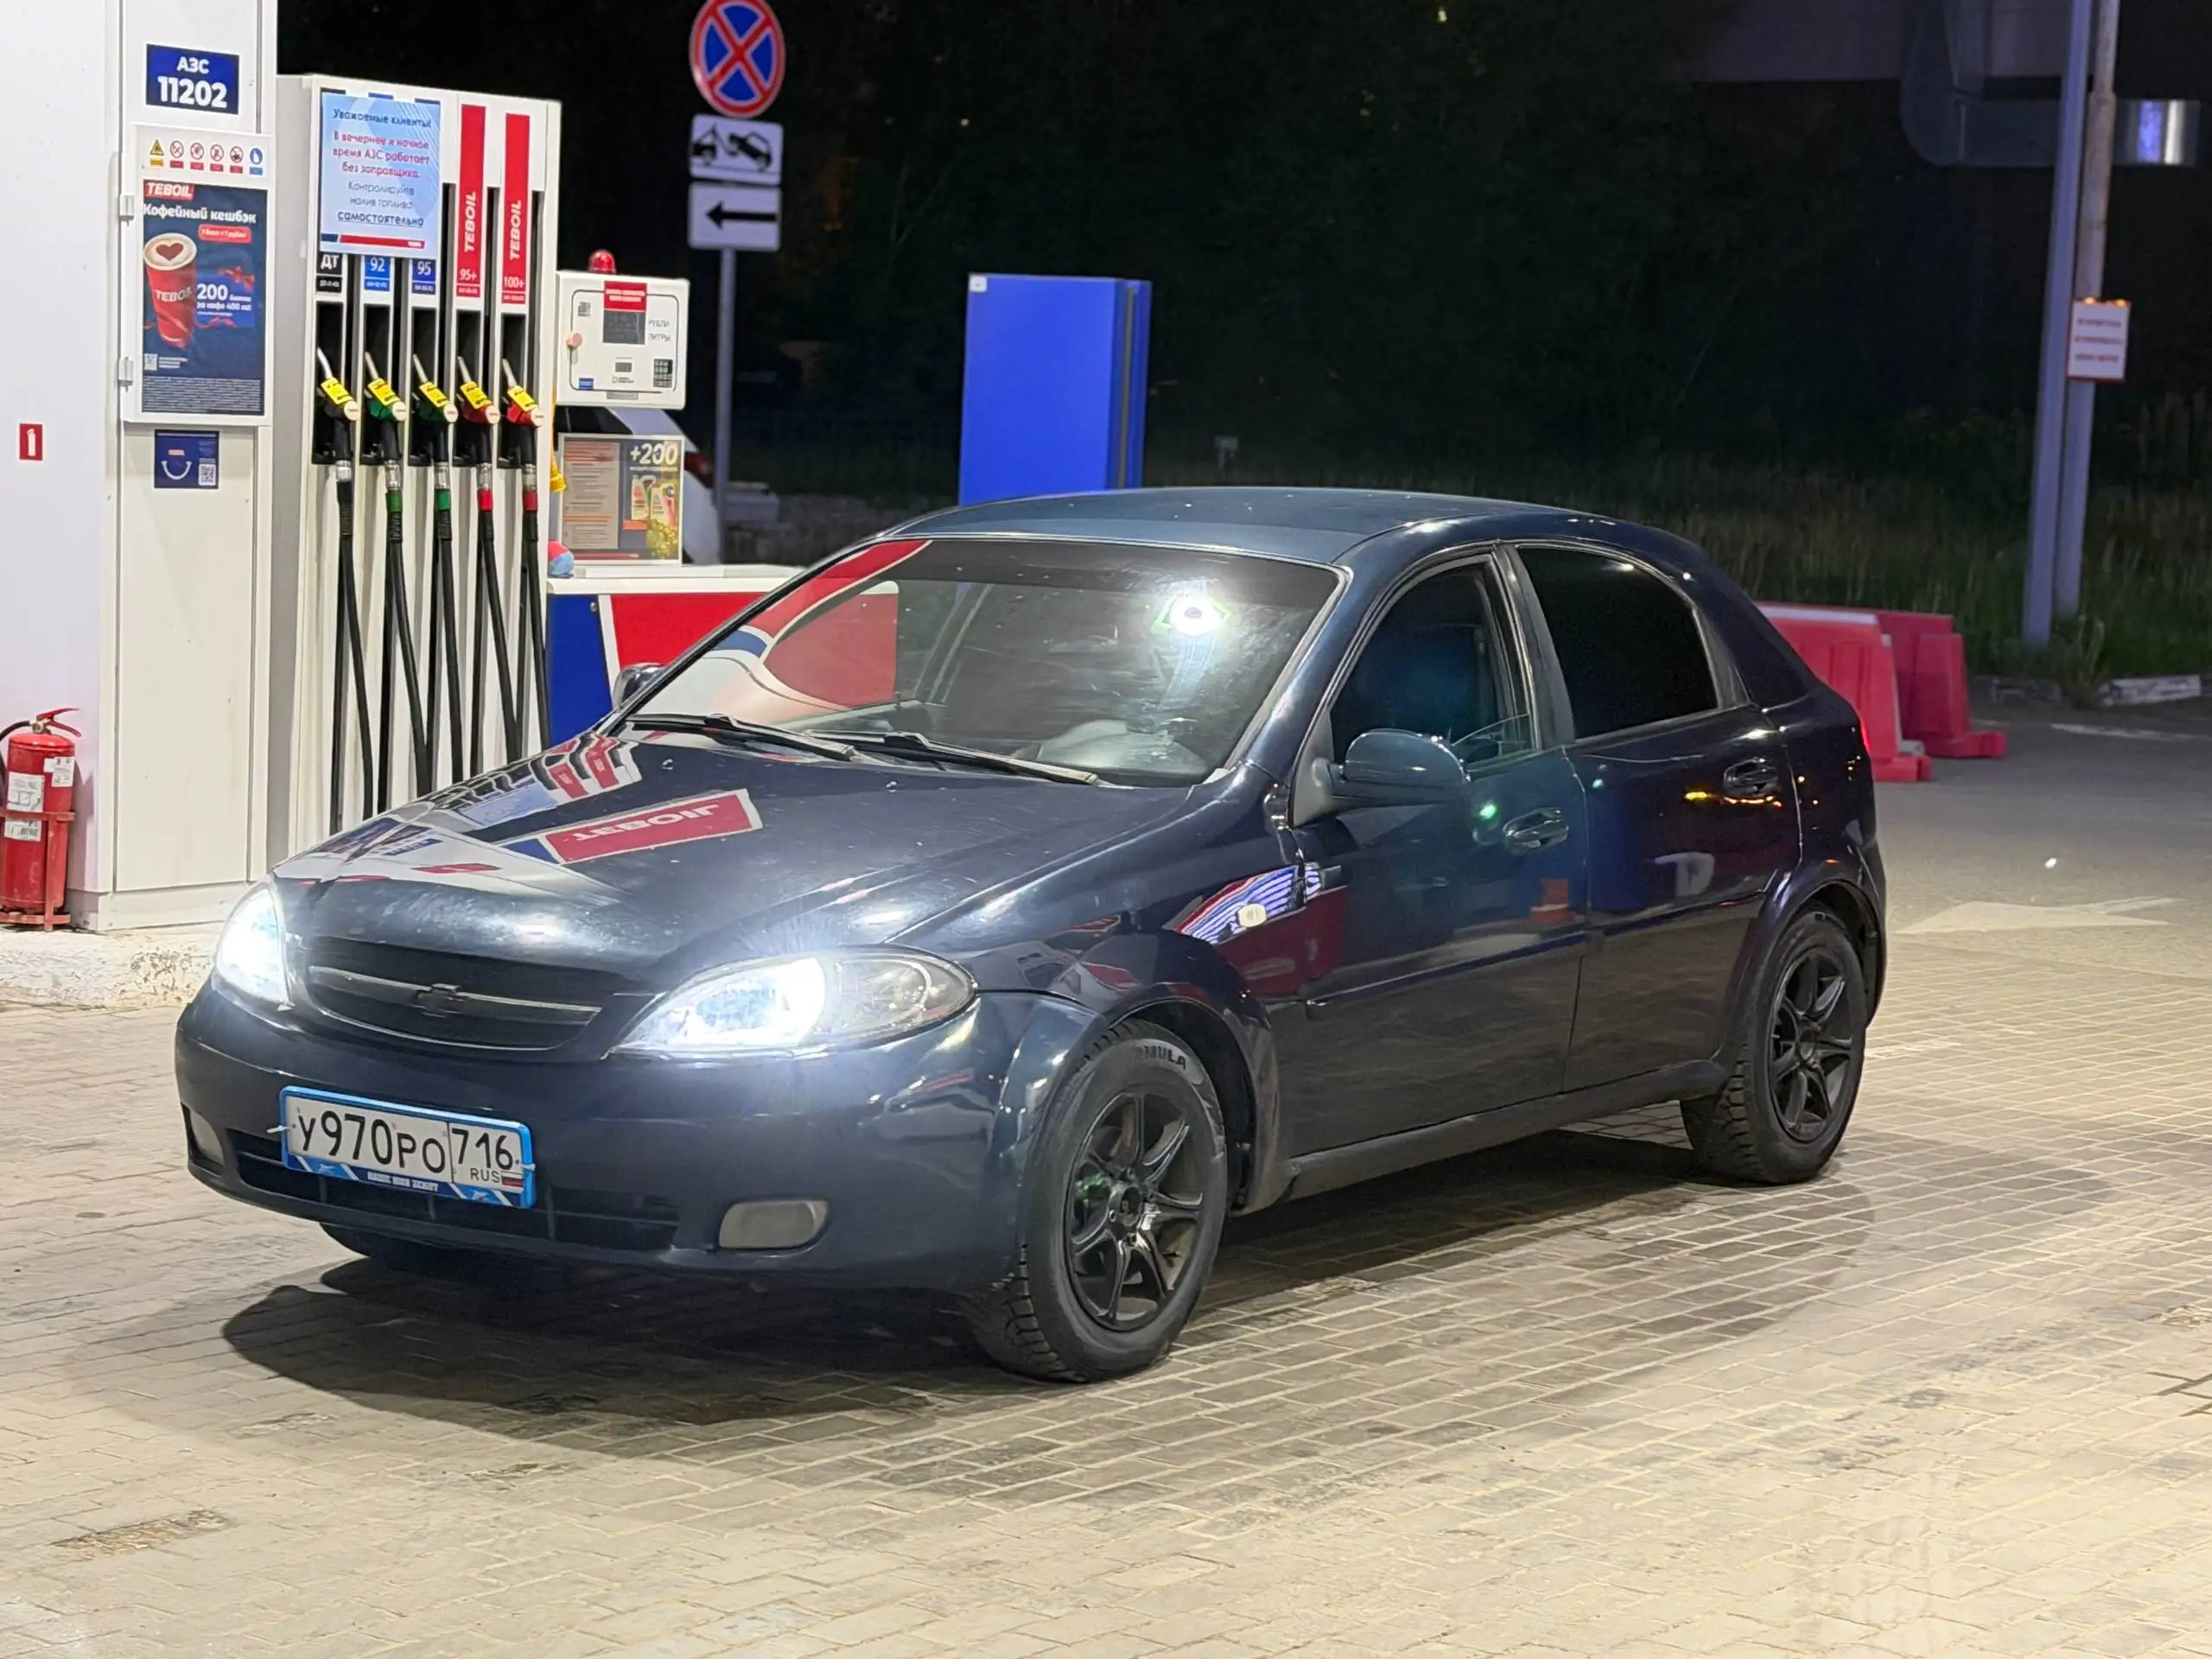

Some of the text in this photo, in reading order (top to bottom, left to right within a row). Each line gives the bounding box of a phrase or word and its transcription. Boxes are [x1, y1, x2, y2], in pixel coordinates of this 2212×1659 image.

[176, 56, 210, 74] АЗС
[157, 76, 227, 109] 11202
[333, 108, 431, 129] Уважаемые клиенты!
[334, 130, 340, 141] В
[341, 133, 386, 146] вечернее
[397, 140, 429, 149] ночное
[333, 148, 429, 164] время АЗС работает
[342, 162, 359, 173] без
[145, 182, 193, 197] TEBOIL
[348, 181, 415, 196] Контролируйте
[350, 197, 413, 209] налив топлива
[143, 202, 257, 224] Кофейный кешбэк
[337, 211, 424, 227] самостоятельно
[464, 191, 476, 253] TEBOIL
[509, 200, 522, 261] TEBOIL
[321, 254, 340, 270] ДТ
[370, 257, 385, 272] 92
[416, 261, 432, 276] 95
[460, 268, 477, 281] 95+
[504, 276, 524, 288] 100+
[197, 283, 228, 301] 200
[630, 442, 678, 466] +200
[297, 1109, 514, 1173] У970РО 716
[470, 1167, 501, 1184] RUS
